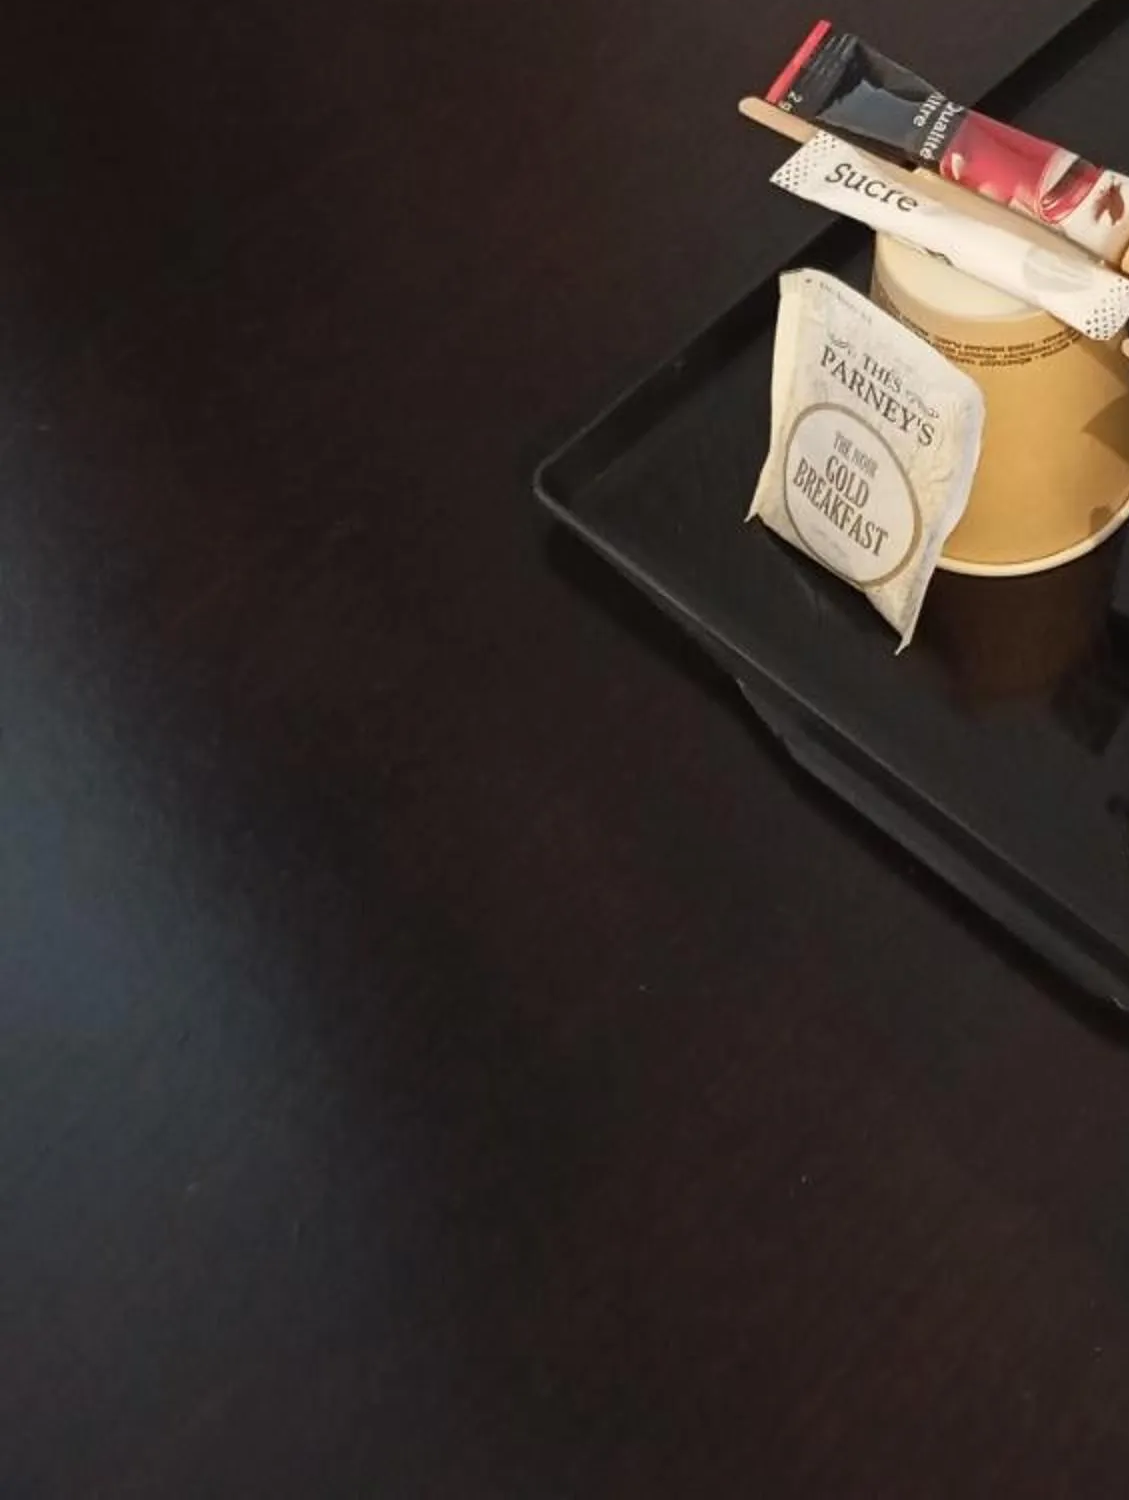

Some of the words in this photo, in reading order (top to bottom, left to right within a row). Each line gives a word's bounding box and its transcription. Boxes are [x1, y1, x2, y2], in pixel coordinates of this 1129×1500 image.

[825, 163, 919, 212] Sucre
[820, 344, 936, 447] PARNEY'S
[793, 457, 889, 557] BREAKFAST
[825, 455, 870, 509] GOLD
